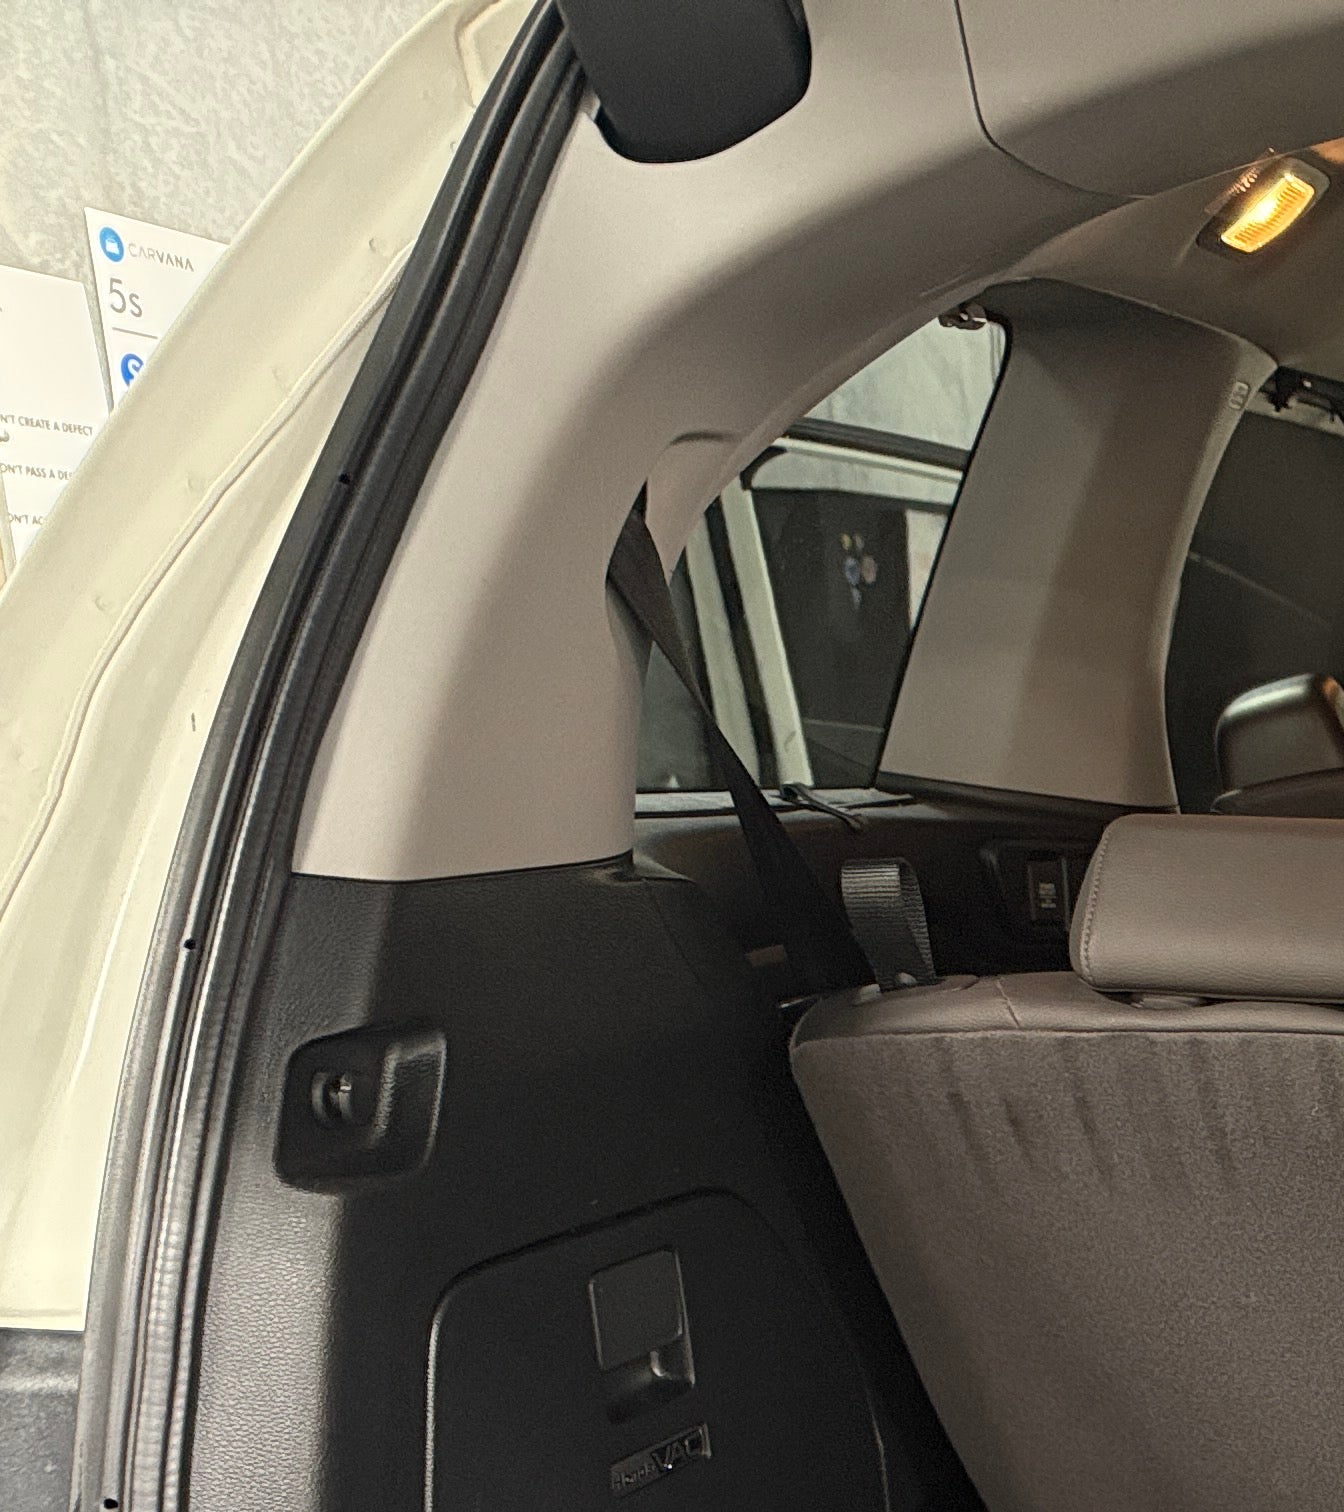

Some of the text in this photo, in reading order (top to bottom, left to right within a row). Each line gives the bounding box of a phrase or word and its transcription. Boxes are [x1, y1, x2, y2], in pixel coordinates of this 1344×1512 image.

[128, 243, 194, 272] CARVANA
[109, 277, 143, 318] 5s
[0, 414, 93, 437] N'T CREATE A DEFECT
[0, 463, 22, 474] ON'T
[26, 466, 46, 478] PASS
[49, 469, 55, 479] A
